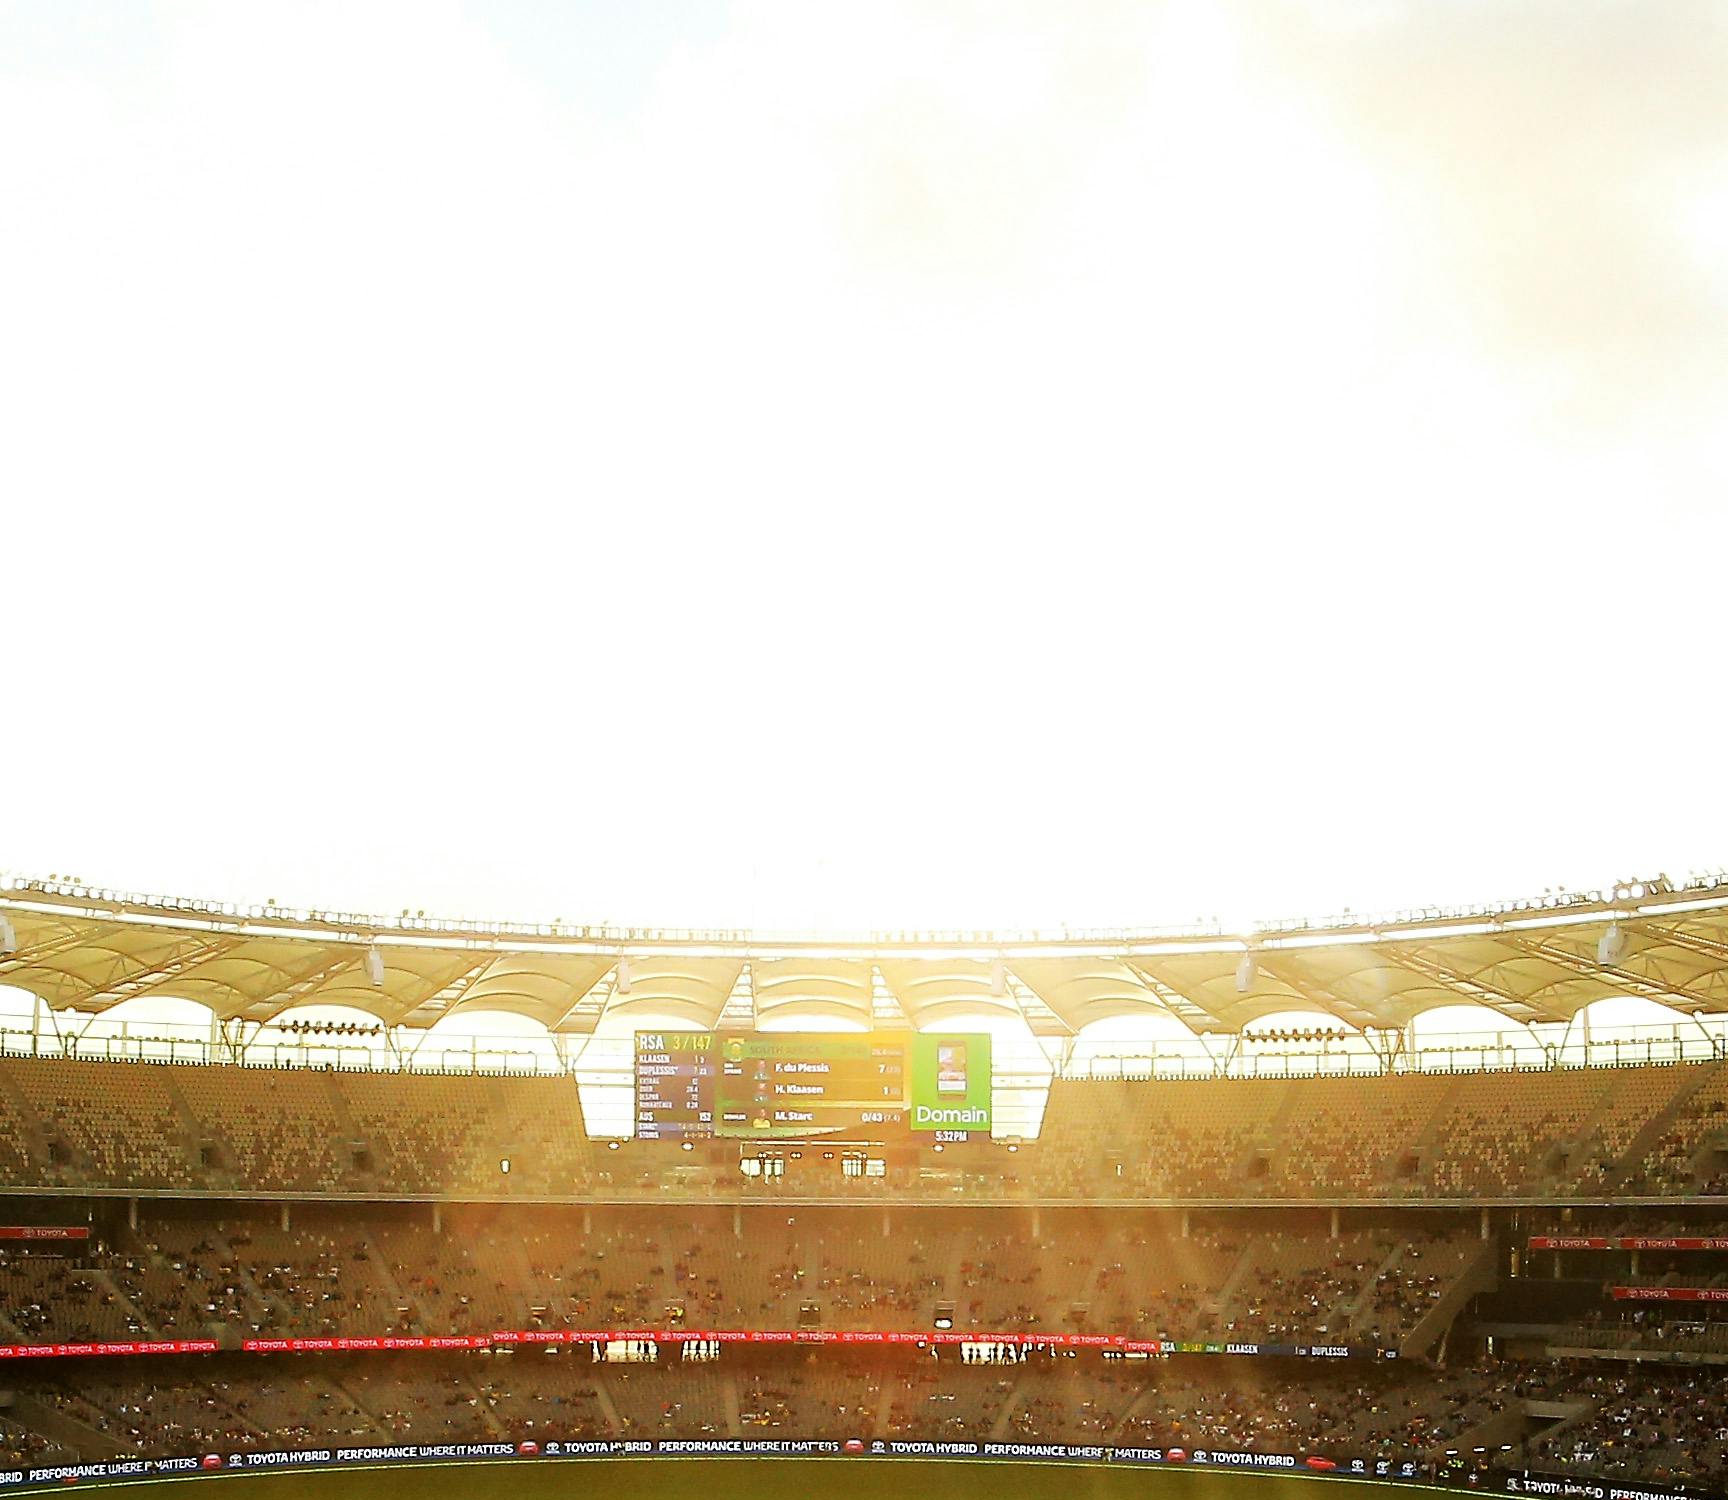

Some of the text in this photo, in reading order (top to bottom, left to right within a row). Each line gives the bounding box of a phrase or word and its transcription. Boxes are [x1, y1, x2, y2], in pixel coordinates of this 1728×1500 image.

[640, 1035, 664, 1049] RSA
[783, 1064, 797, 1072] du
[798, 1064, 829, 1072] Plessis
[787, 1085, 823, 1094] Klaasen
[639, 1112, 653, 1121] AUS
[789, 1112, 812, 1120] Starc
[862, 1113, 882, 1122] 0/43
[917, 1106, 987, 1123] Domain
[27, 1347, 54, 1355] TOYOTA
[68, 1346, 93, 1354] TOYOTA
[107, 1344, 134, 1353] TOYOTA
[148, 1343, 175, 1352] TOYOTA
[188, 1342, 215, 1351] TOYOTA
[258, 1341, 287, 1350] TOYOTA
[304, 1340, 332, 1348] TOYOTA
[349, 1340, 377, 1348] TOYOTA
[395, 1339, 424, 1348] TOYOTA
[440, 1338, 469, 1347] TOYOTA
[535, 1332, 564, 1341] TOYOTA
[580, 1332, 609, 1341] TOYOTA
[626, 1332, 655, 1340] TOYOTA
[672, 1332, 701, 1340] TOYOTA
[719, 1332, 747, 1340] TOYOTA
[764, 1333, 792, 1341] TOYOTA
[809, 1333, 837, 1341] TOYOTA
[854, 1333, 882, 1342] TOYOTA
[900, 1333, 928, 1342] TOYOTA
[945, 1333, 973, 1342] TOYOTA
[990, 1334, 1019, 1343] TOYOTA
[1035, 1335, 1064, 1343] TOYOTA
[1080, 1336, 1110, 1345] TOYOTA
[1227, 1344, 1258, 1354] KLAASEN
[1312, 1346, 1348, 1356] DUPLESSIS
[247, 1443, 514, 1465] TOYOTA HYBRID PERFORMANCE WHERE IT MATTERS
[564, 1442, 609, 1453] TOYOTA
[659, 1441, 742, 1451] PERFORMANCE
[743, 1441, 781, 1451] WHERE
[781, 1441, 791, 1451] IT
[890, 1442, 935, 1453] TOYOTA
[936, 1442, 978, 1454] HYBRID
[984, 1444, 1066, 1457] PERFORMANCE
[1115, 1448, 1162, 1460] MATTERS
[1211, 1452, 1295, 1467] TOYOTA HYBRID
[29, 1463, 105, 1481] PERFORMANCE
[108, 1460, 144, 1474] WHERE
